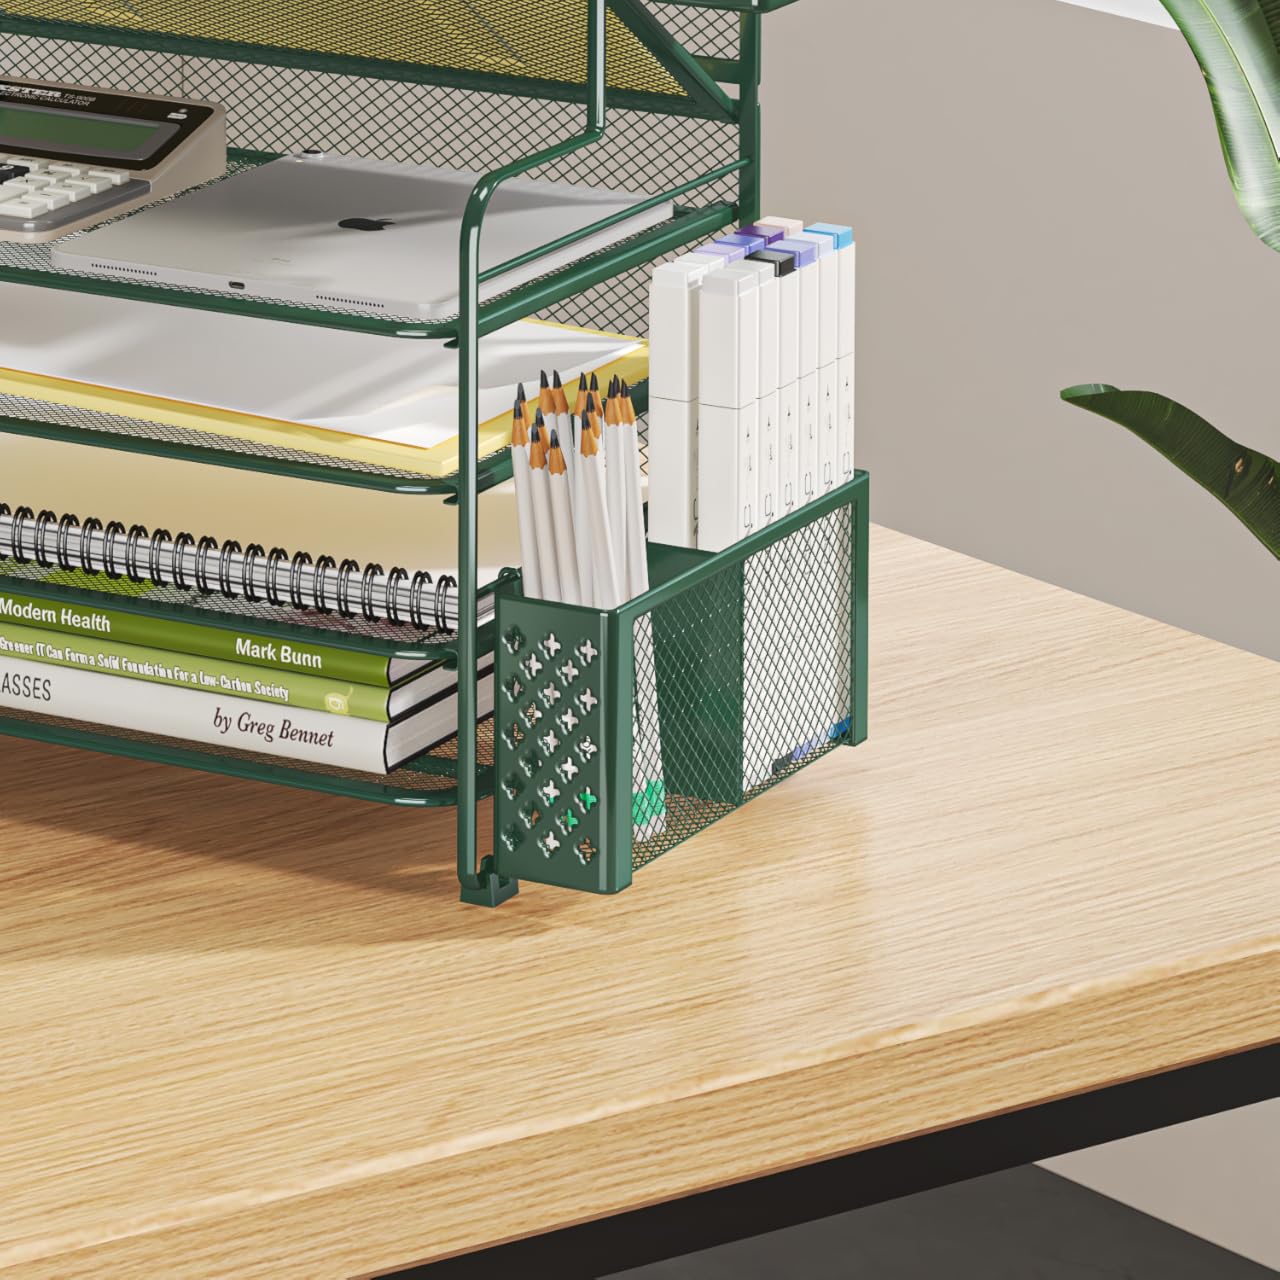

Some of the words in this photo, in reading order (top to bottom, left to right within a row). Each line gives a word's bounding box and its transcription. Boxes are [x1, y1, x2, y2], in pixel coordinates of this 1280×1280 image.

[39, 95, 91, 107] CALCULATOR
[60, 608, 111, 632] Health
[235, 638, 277, 661] Mark
[280, 645, 322, 669] Bunn
[0, 637, 34, 655] Greener
[36, 642, 46, 657] IT
[46, 645, 64, 660] Can
[65, 648, 88, 664] Form
[88, 655, 96, 665] a
[97, 653, 120, 670] Solid
[121, 657, 172, 680] Foundation
[173, 667, 190, 682] For
[191, 673, 198, 684] a
[199, 671, 253, 694] Low-Carbon
[254, 681, 289, 702] Society
[213, 707, 232, 734] by
[237, 711, 276, 743] Greg
[278, 718, 335, 748] Bennet
